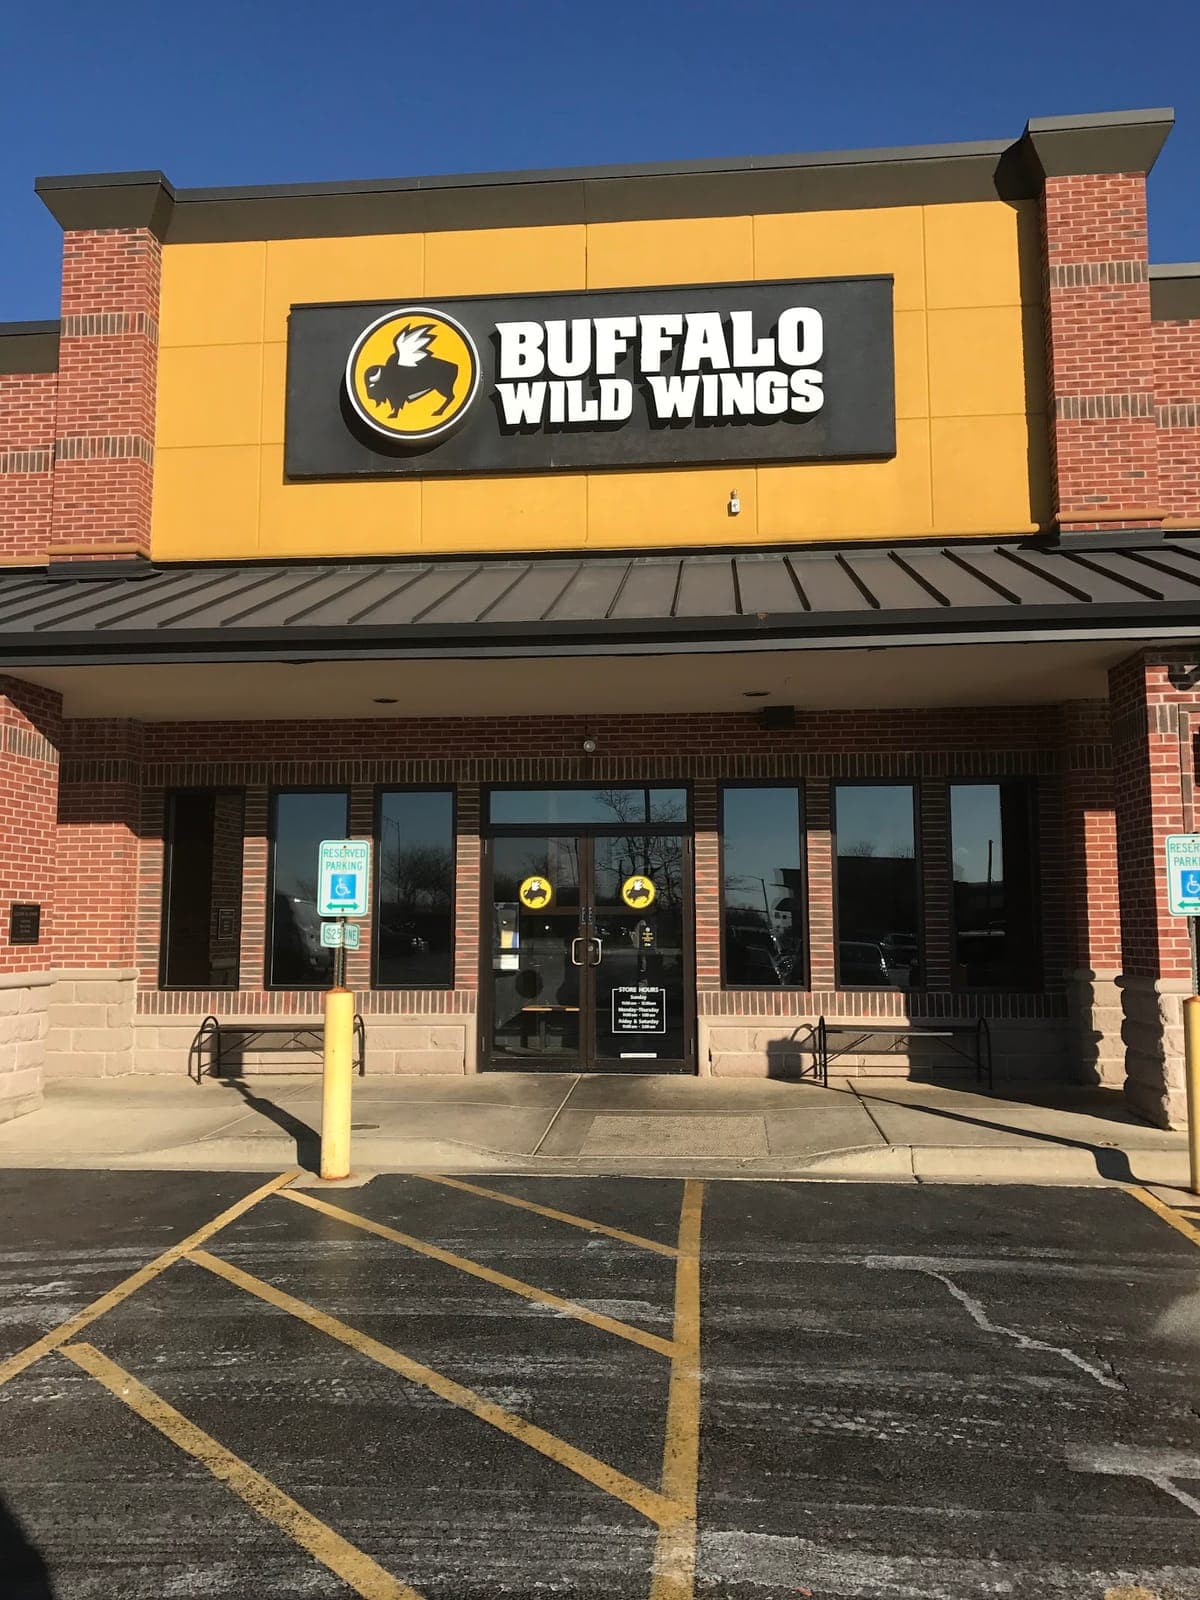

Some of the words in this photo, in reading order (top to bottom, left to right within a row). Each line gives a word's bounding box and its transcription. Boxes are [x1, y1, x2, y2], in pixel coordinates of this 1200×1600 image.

[495, 307, 824, 379] BUFFALO
[495, 378, 634, 425] WILD
[646, 369, 825, 419] WINGS
[323, 848, 366, 858] RESERVED
[326, 861, 363, 870] PARKING
